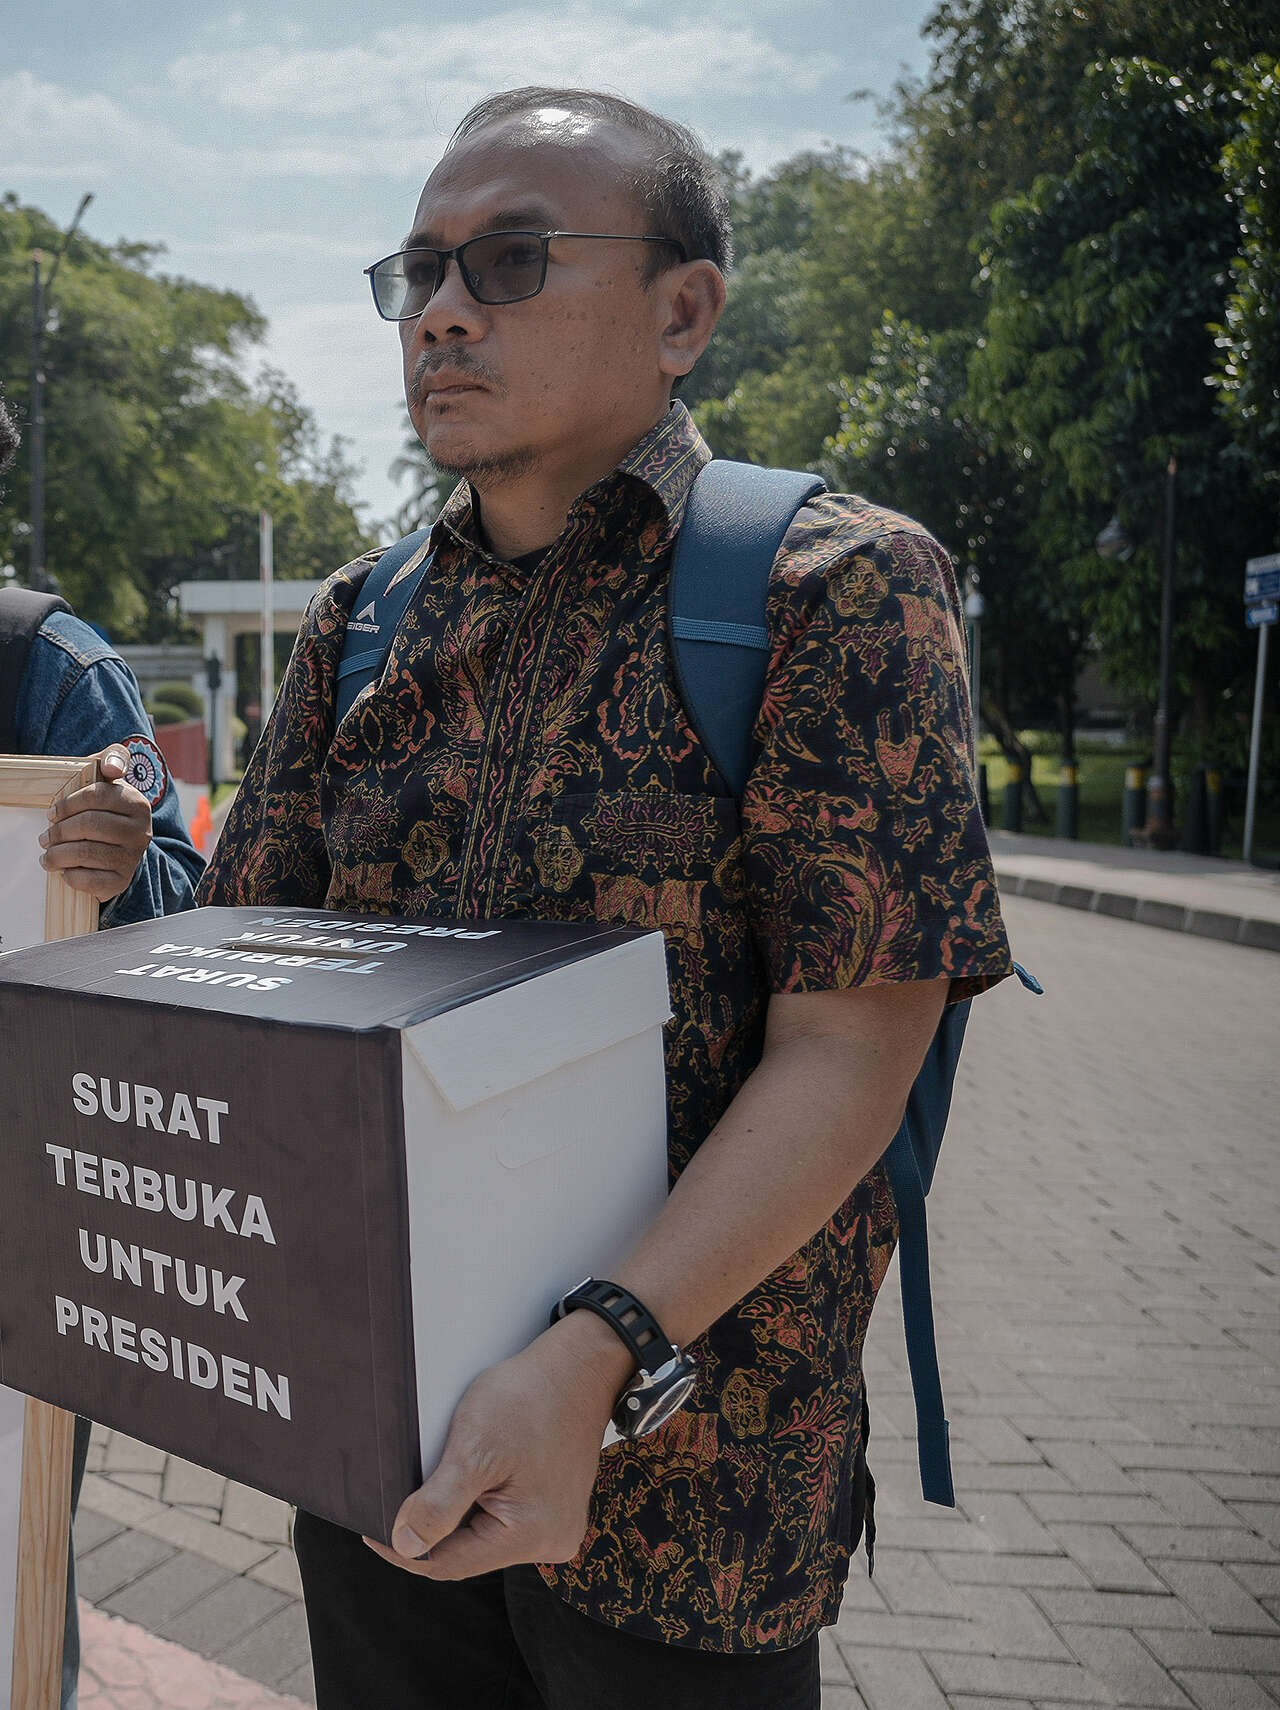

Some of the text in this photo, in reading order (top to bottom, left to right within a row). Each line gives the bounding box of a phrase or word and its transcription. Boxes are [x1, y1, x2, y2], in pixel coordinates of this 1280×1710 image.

[347, 622, 380, 634] EIGER
[221, 932, 408, 953] UNTUK
[243, 917, 502, 940] PRESIDEN
[149, 944, 384, 974] TERBUKA
[115, 964, 293, 991] SURAT
[72, 1072, 229, 1145] SURAT
[45, 1142, 277, 1245] TERBUKA
[78, 1227, 249, 1322] UNTUK
[54, 1295, 292, 1421] PRESIDEN
